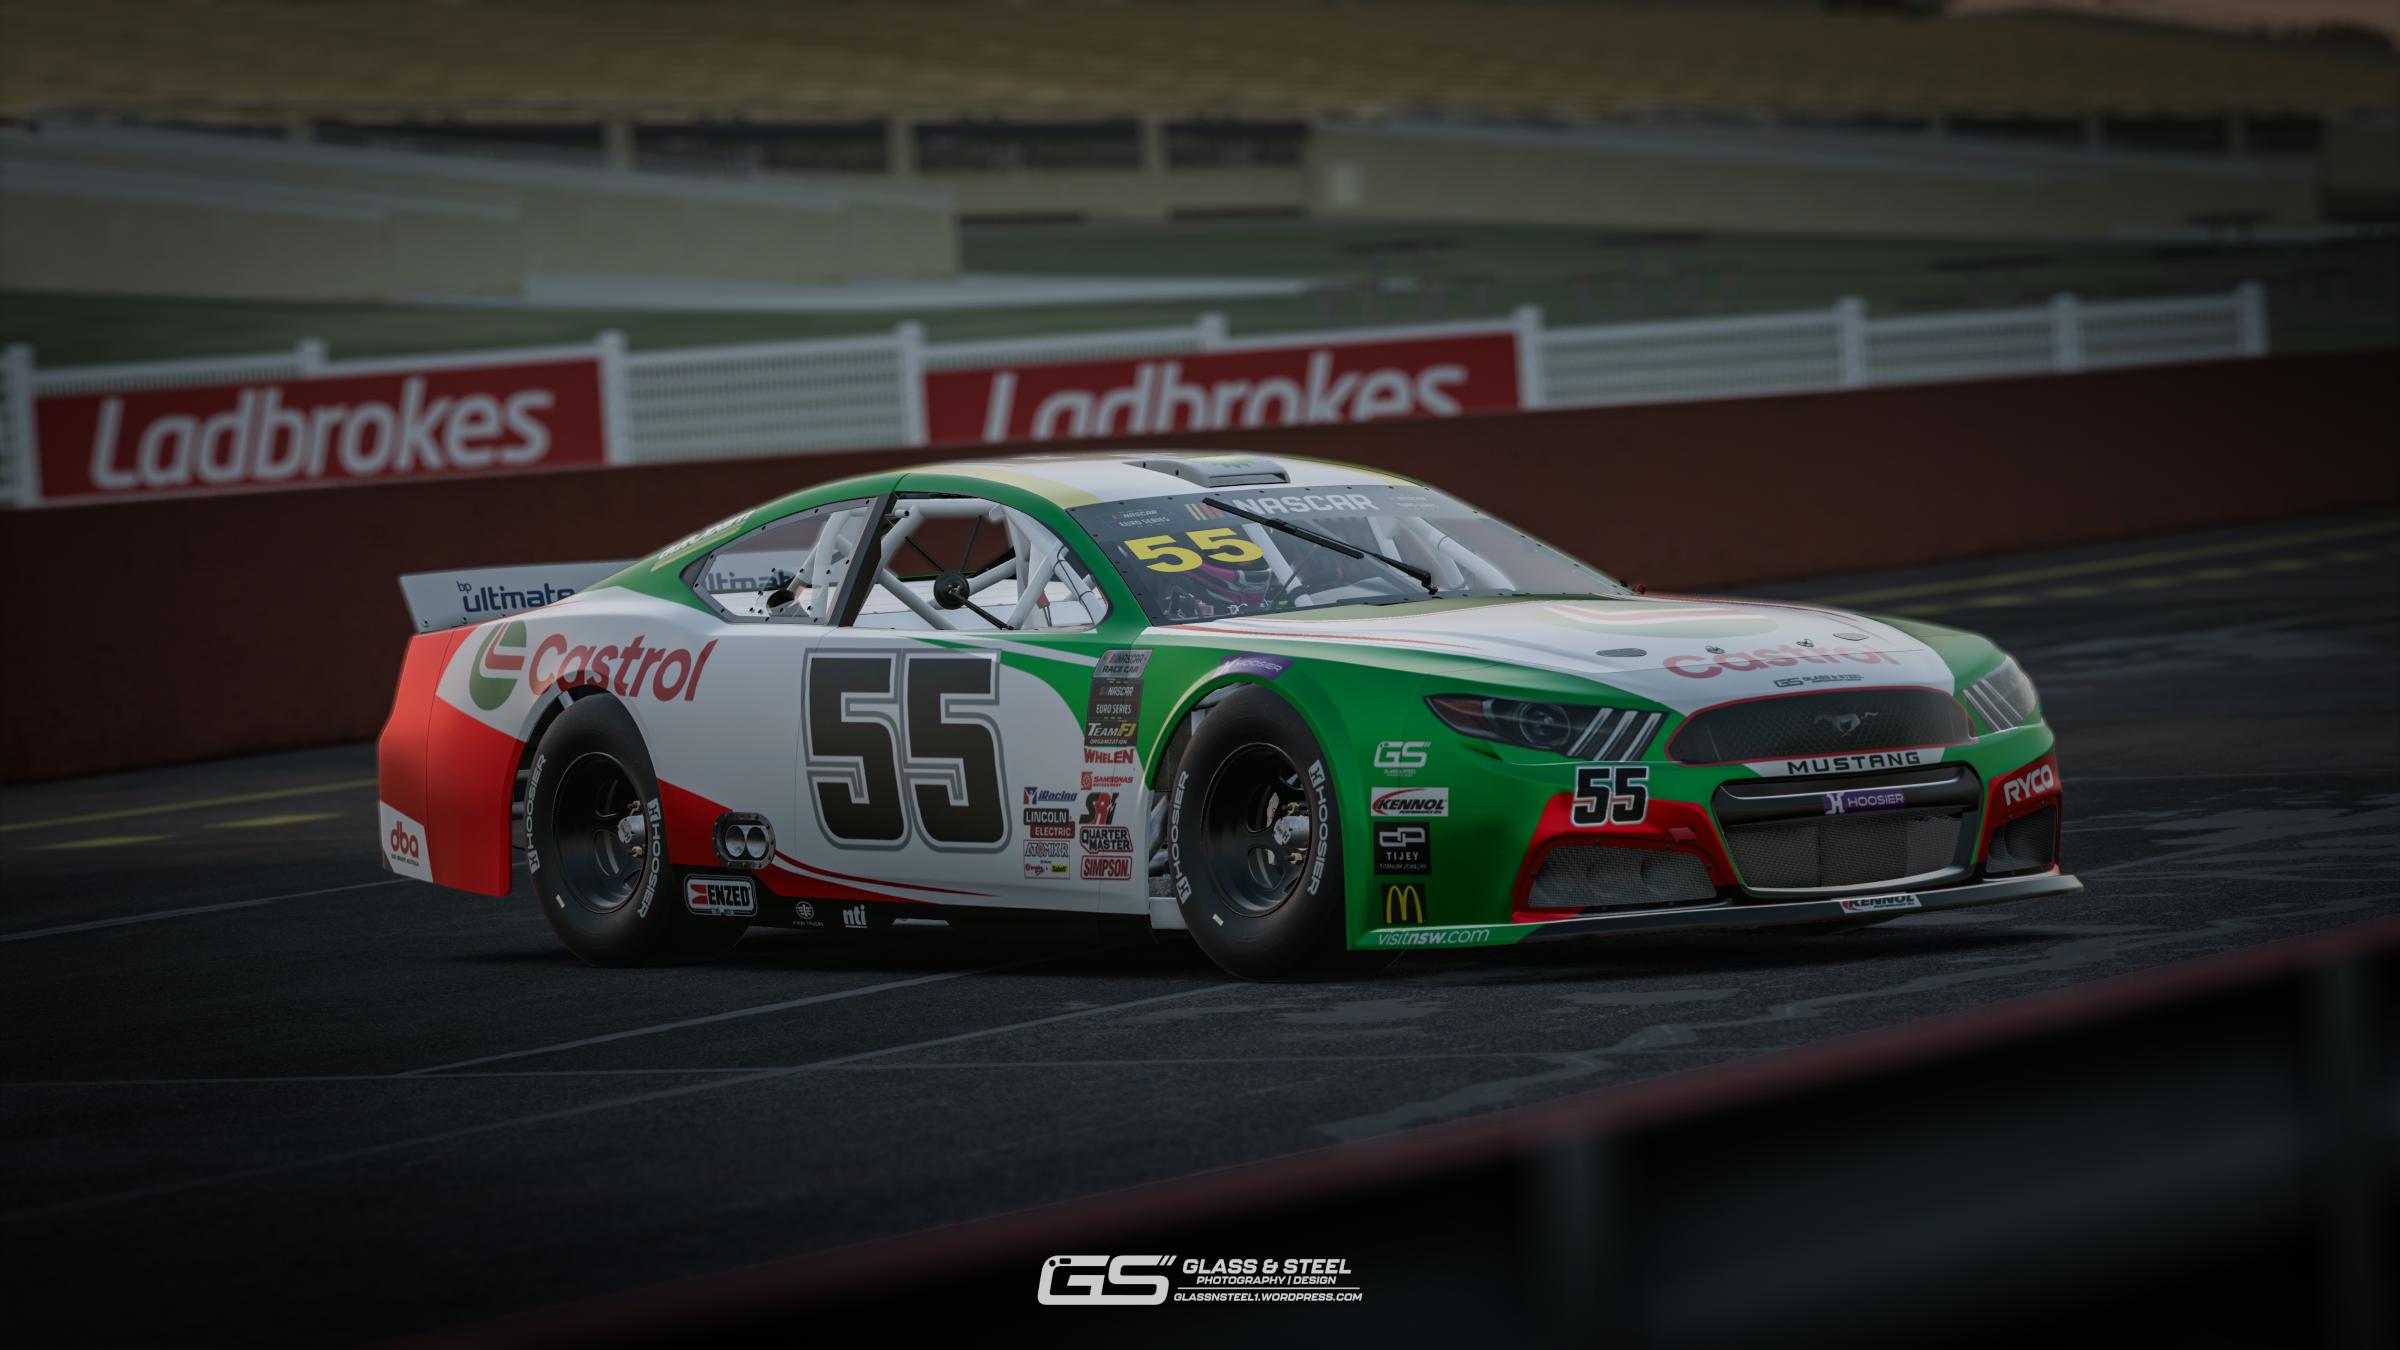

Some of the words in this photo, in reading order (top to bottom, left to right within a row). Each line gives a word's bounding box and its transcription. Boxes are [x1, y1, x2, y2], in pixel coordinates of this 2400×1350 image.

[90, 376, 556, 491] Ladbrokes
[1231, 493, 1381, 516] NASCAR
[1123, 528, 1264, 573] 55
[456, 580, 472, 593] bp
[529, 634, 719, 702] Castrol
[1662, 643, 1901, 679] Castrol
[1107, 686, 1134, 697] NASCAR
[1096, 703, 1112, 714] EURO
[1112, 703, 1132, 714] SERIES
[802, 648, 1013, 854] 55
[1084, 748, 1134, 764] WHELEN
[1787, 751, 1920, 775] MUSTANG
[1038, 790, 1077, 802] iRacing
[2003, 763, 2054, 807] RYCO
[526, 752, 548, 850] HOOSIER
[1377, 799, 1445, 811] KENNOL
[1571, 766, 1650, 827] 55
[1848, 793, 1905, 808] HOOSIER
[1026, 811, 1068, 824] LINCOLN
[1171, 770, 1189, 880] HOOSIER
[390, 820, 419, 858] dba
[1035, 826, 1072, 838] ELECTRIC
[1081, 829, 1128, 844] QUARTER
[1307, 784, 1329, 896] HOOSIER
[1089, 840, 1131, 850] MASTER
[1386, 851, 1419, 861] TIJEY
[637, 822, 661, 920] HOOSIER
[1083, 859, 1129, 877] SIMPSON
[707, 884, 750, 907] ENZED
[842, 904, 867, 926] nti
[1377, 928, 1490, 946] visitnsw.com
